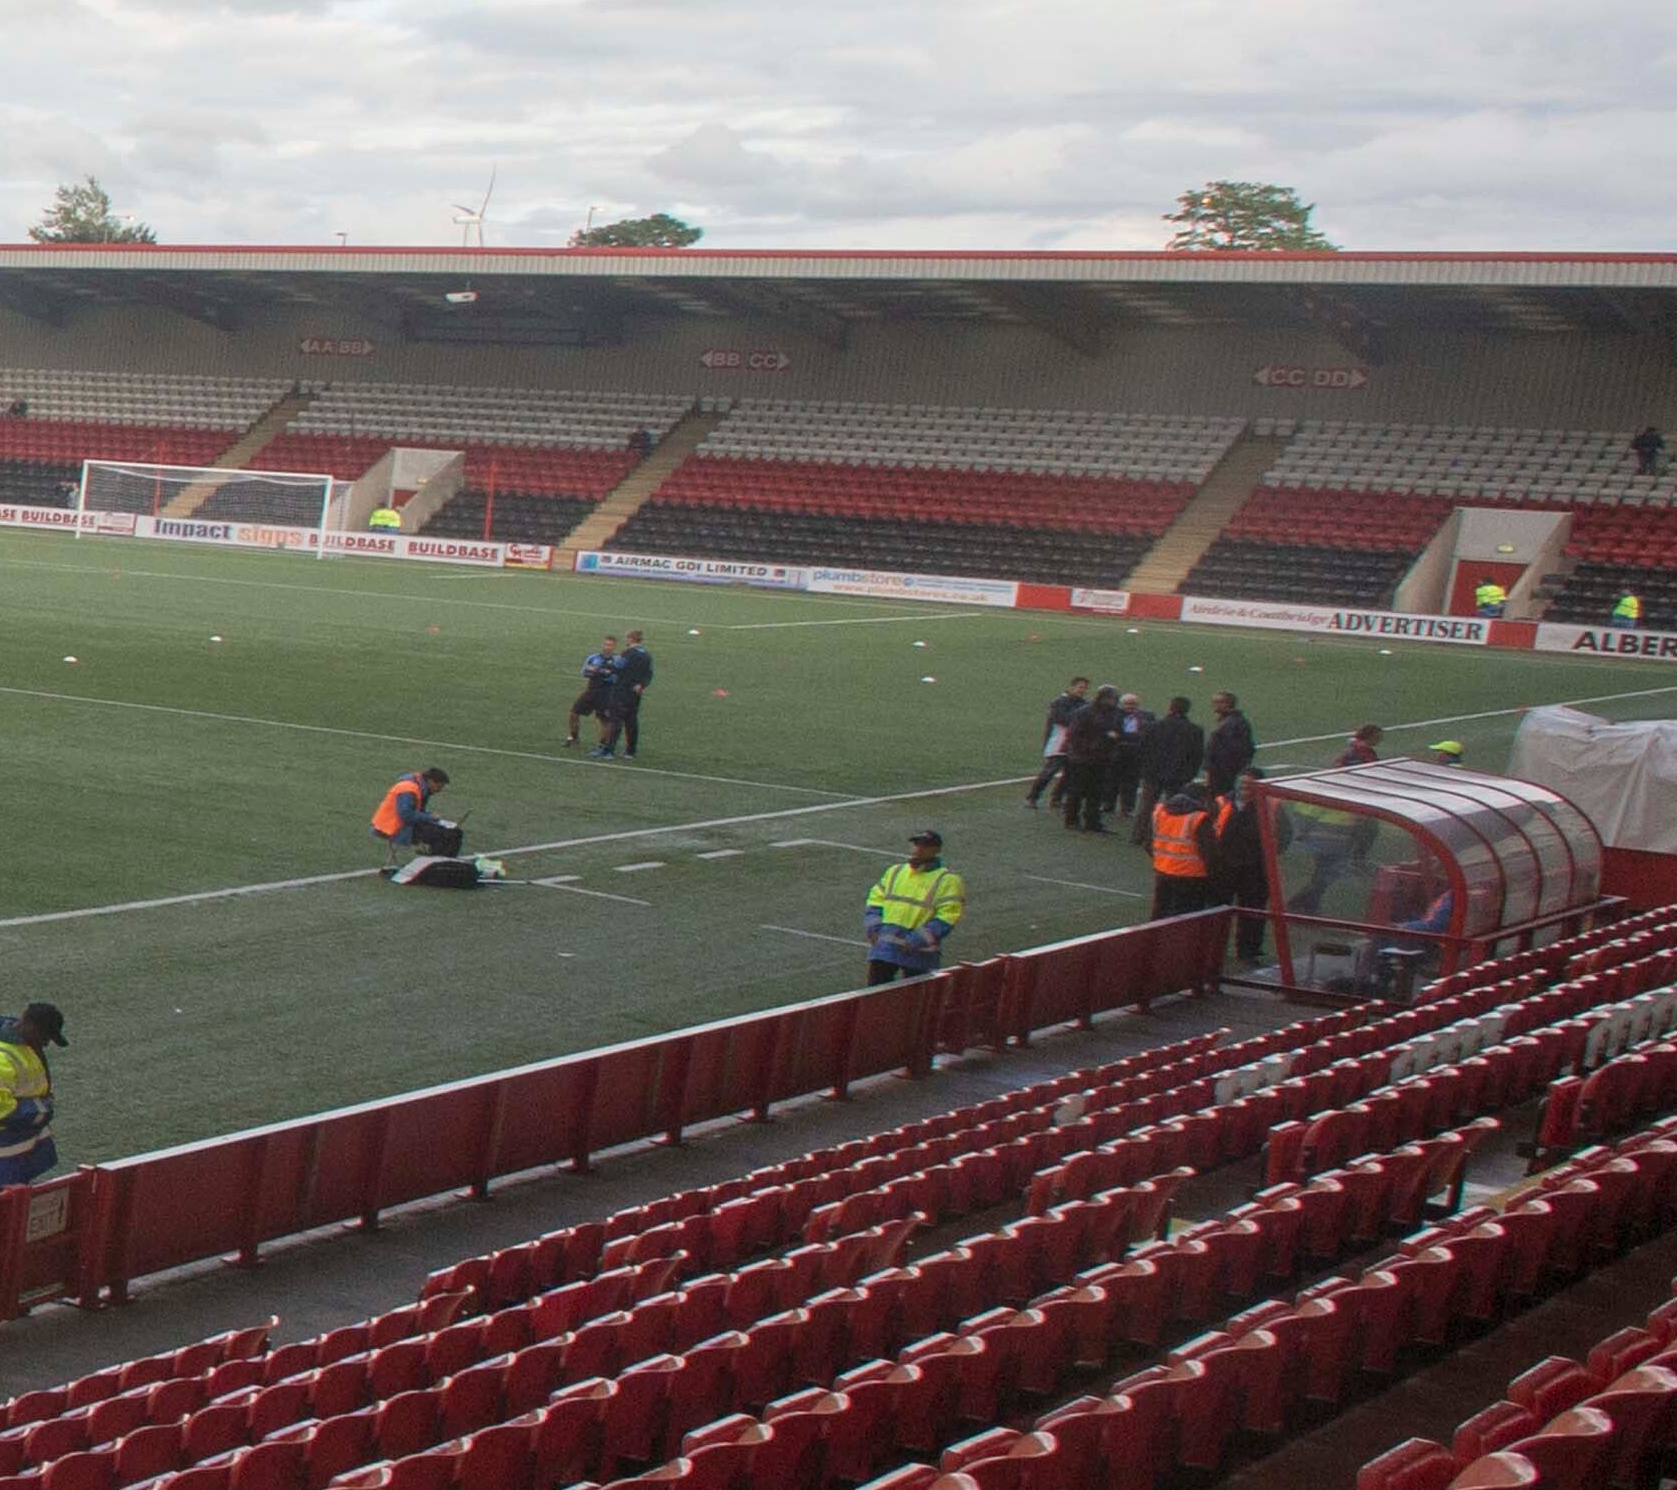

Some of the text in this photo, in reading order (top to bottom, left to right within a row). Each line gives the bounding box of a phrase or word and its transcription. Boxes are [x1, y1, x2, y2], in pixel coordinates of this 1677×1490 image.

[154, 518, 233, 540] Impact
[408, 541, 499, 560] BUILDBASE
[706, 563, 768, 577] LIMITED
[1327, 612, 1485, 641] ADVERTISER
